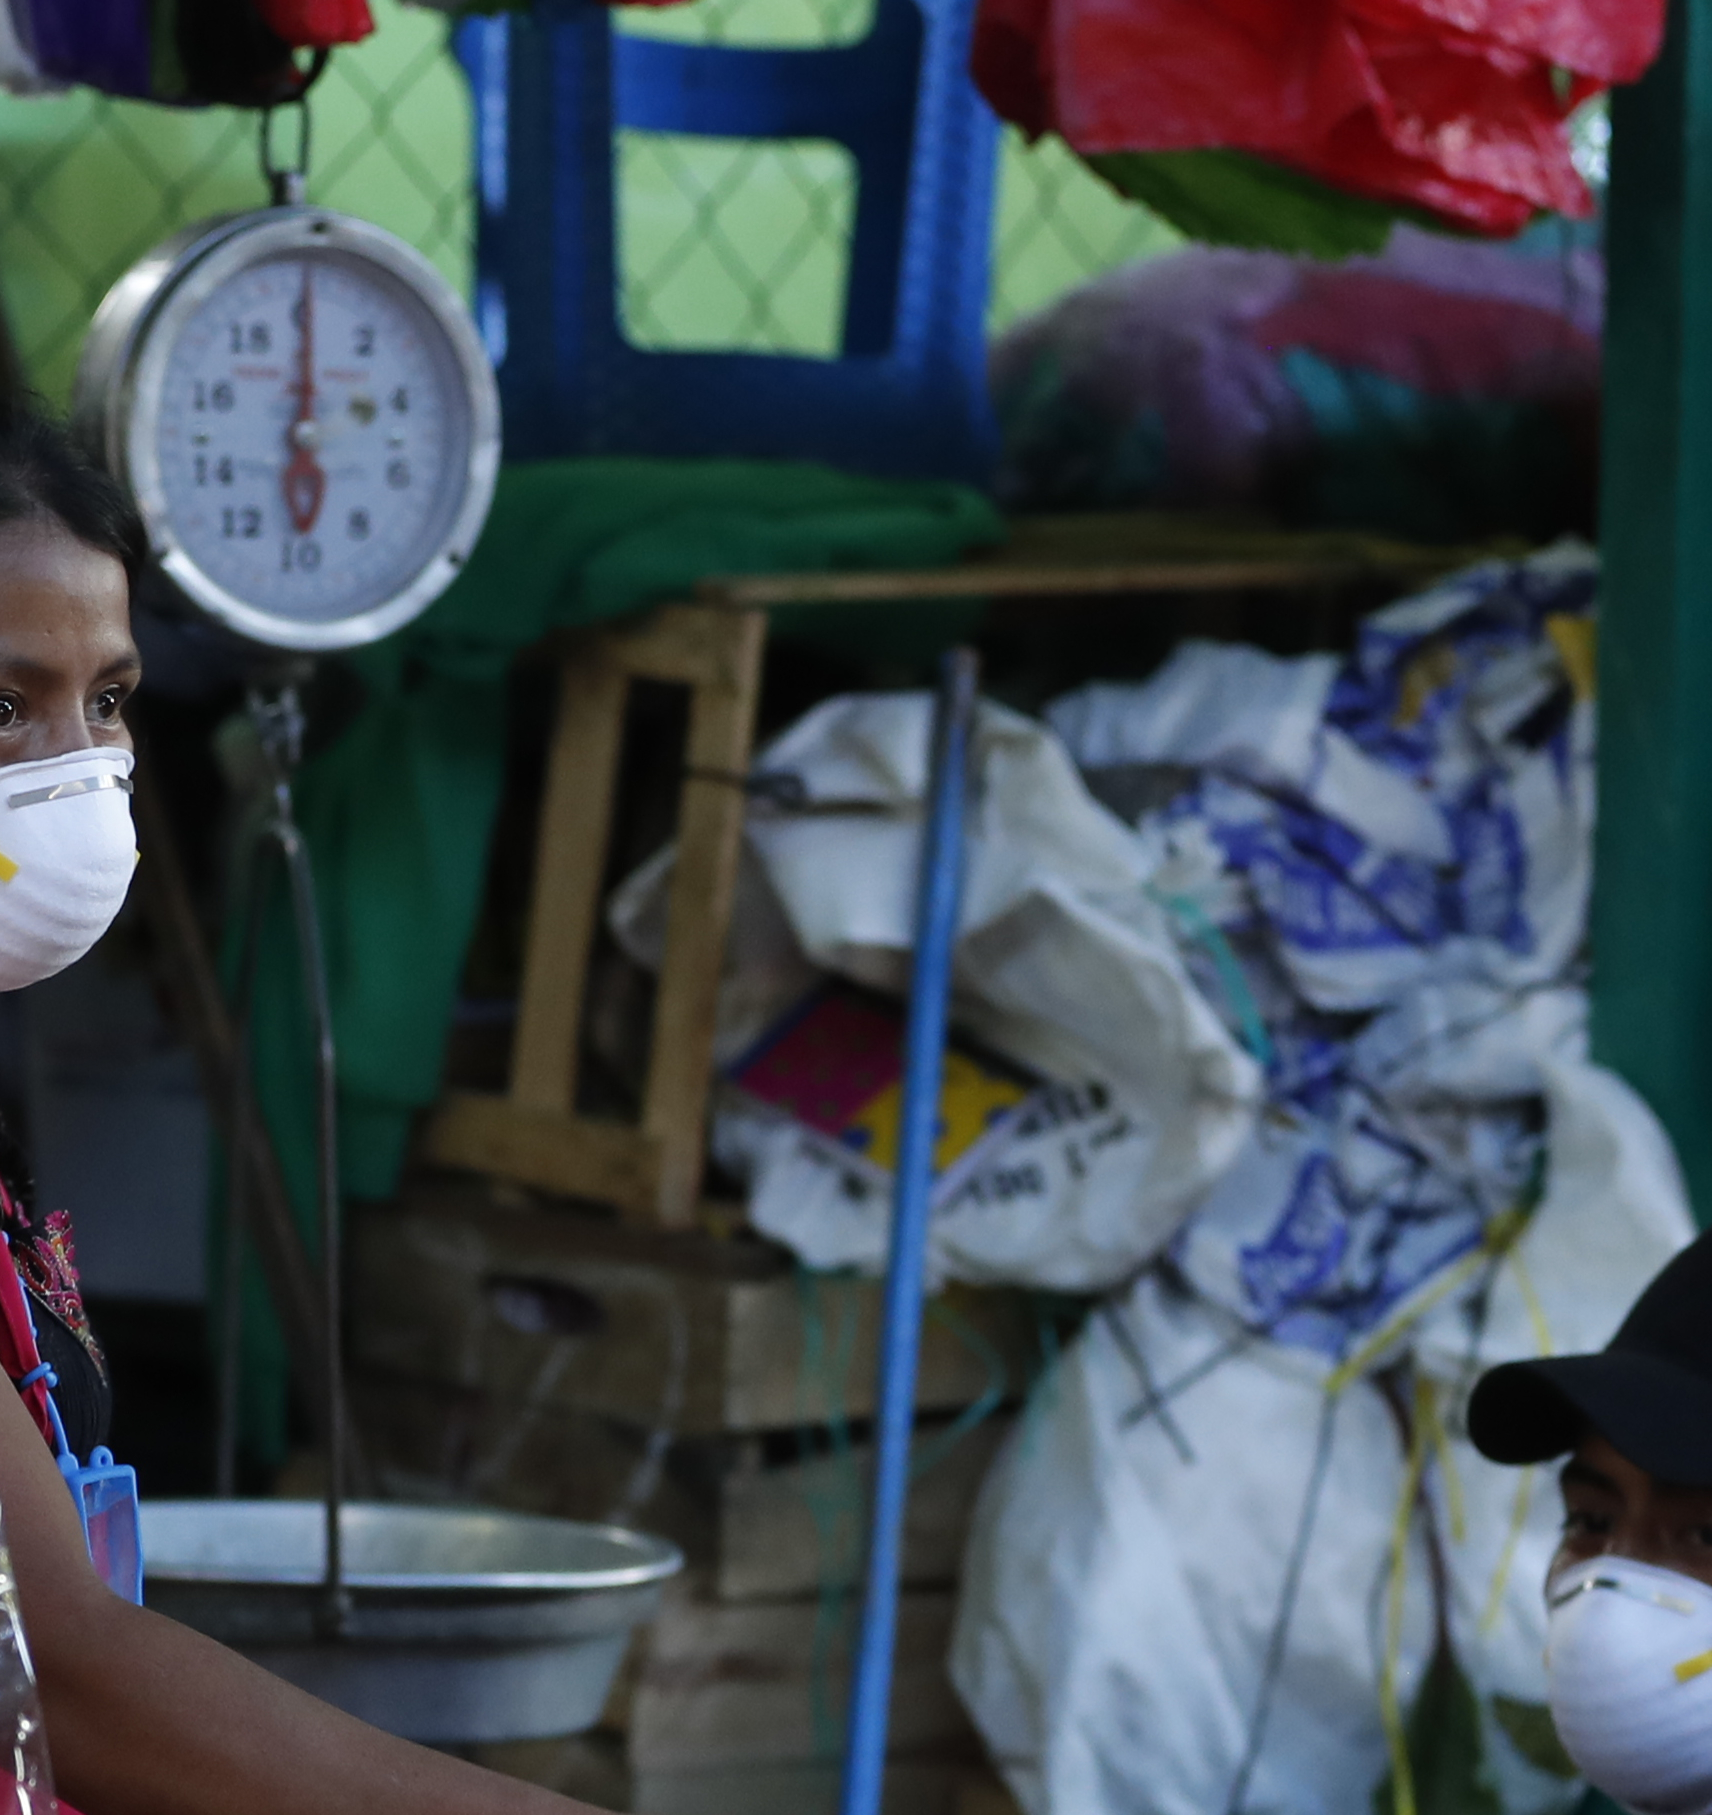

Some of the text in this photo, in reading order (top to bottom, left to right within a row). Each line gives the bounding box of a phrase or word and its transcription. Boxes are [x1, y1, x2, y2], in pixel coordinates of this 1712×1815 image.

[352, 322, 375, 357] 2
[222, 505, 263, 539] 12
[281, 540, 323, 574] 10
